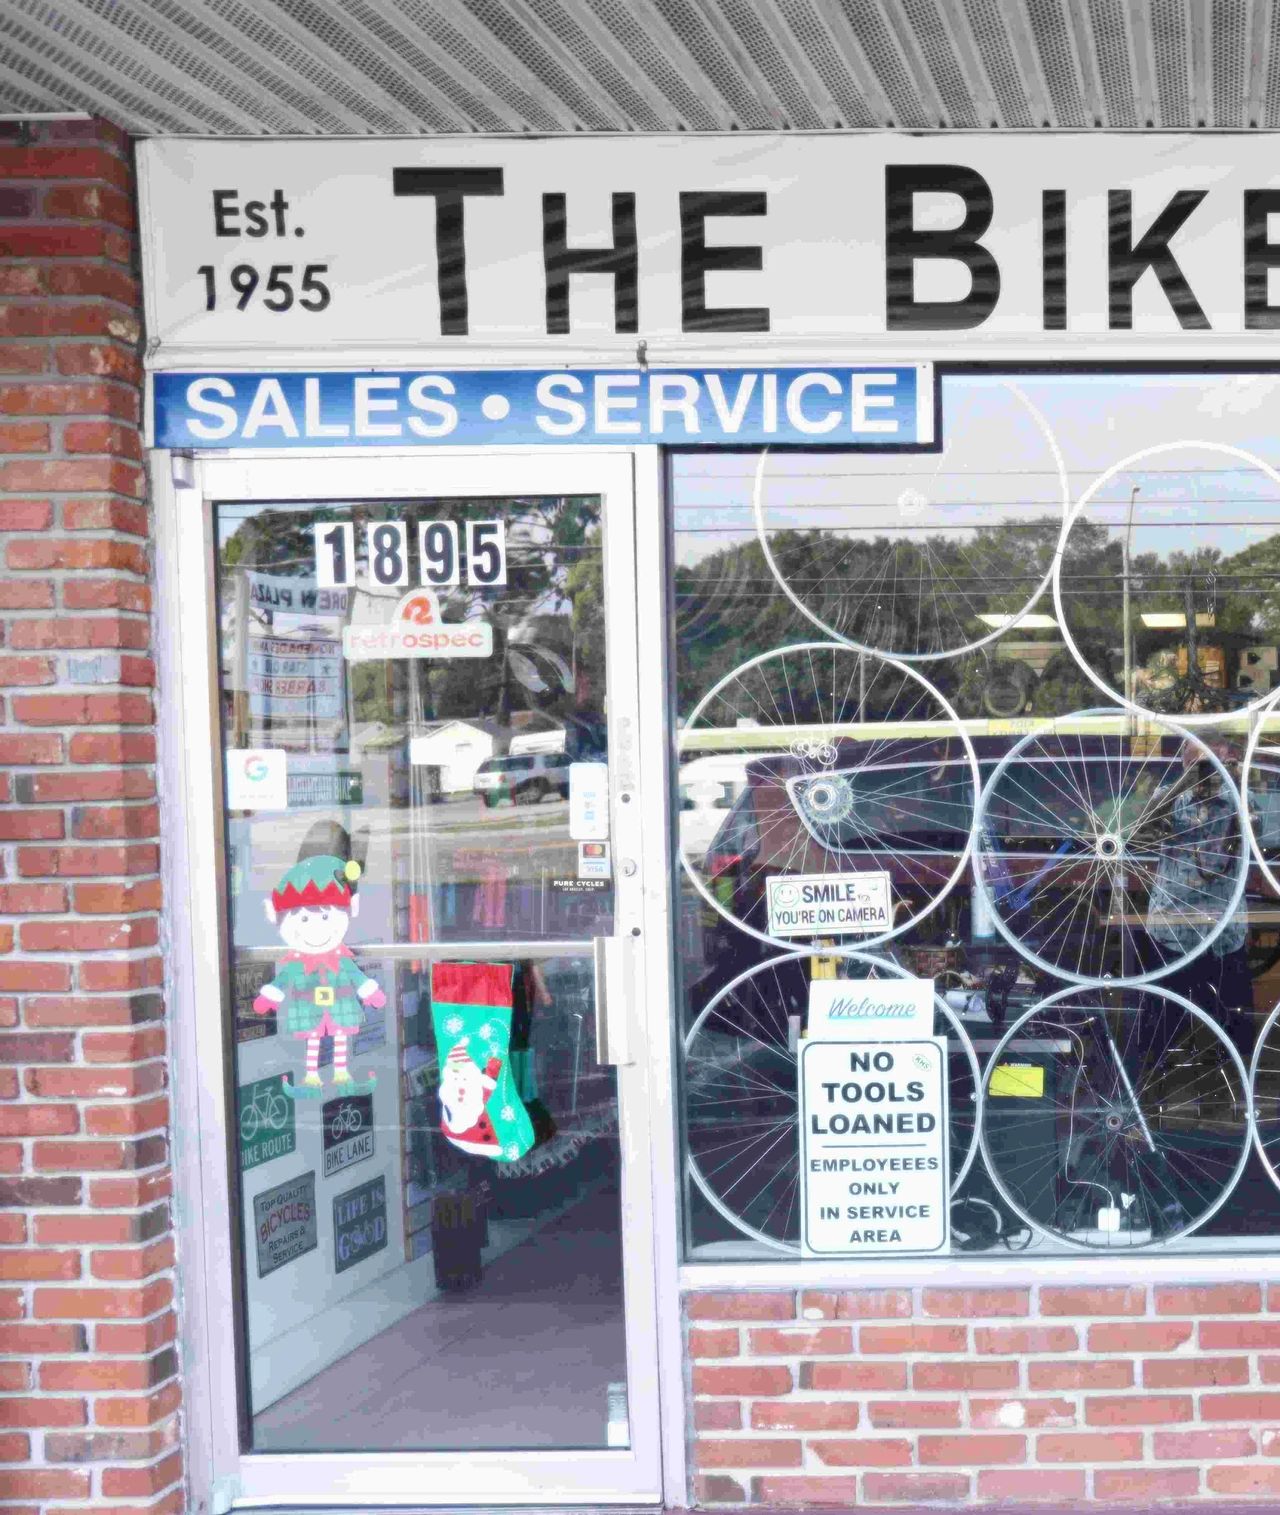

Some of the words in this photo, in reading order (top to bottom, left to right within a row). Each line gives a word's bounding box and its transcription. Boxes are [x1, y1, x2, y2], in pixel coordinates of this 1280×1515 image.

[213, 189, 306, 239] Est.
[393, 167, 770, 336] THE
[198, 264, 331, 314] 1955
[186, 376, 458, 440] SALES
[535, 371, 900, 437] SERVICE
[323, 522, 501, 585] 1895
[350, 632, 484, 650] retrospec
[801, 883, 857, 904] SMILE
[775, 910, 816, 926] YOU'RE
[819, 910, 836, 924] ON
[837, 907, 886, 923] CAMERA
[828, 996, 917, 1020] Welcome
[850, 1051, 895, 1073] NO
[822, 1081, 926, 1103] TOOLS
[811, 1113, 937, 1136] LOANED
[262, 1132, 292, 1159] ROUTE
[326, 1150, 344, 1170] BIKE
[347, 1136, 371, 1160] LANE
[849, 1182, 901, 1196] ONLY
[336, 1195, 367, 1225] LIFE
[819, 1206, 841, 1220] IN
[847, 1204, 931, 1219] SERVICE
[260, 1203, 311, 1244] BICYCLES
[849, 1229, 902, 1244] AREA
[273, 1240, 304, 1264] SERVICE
